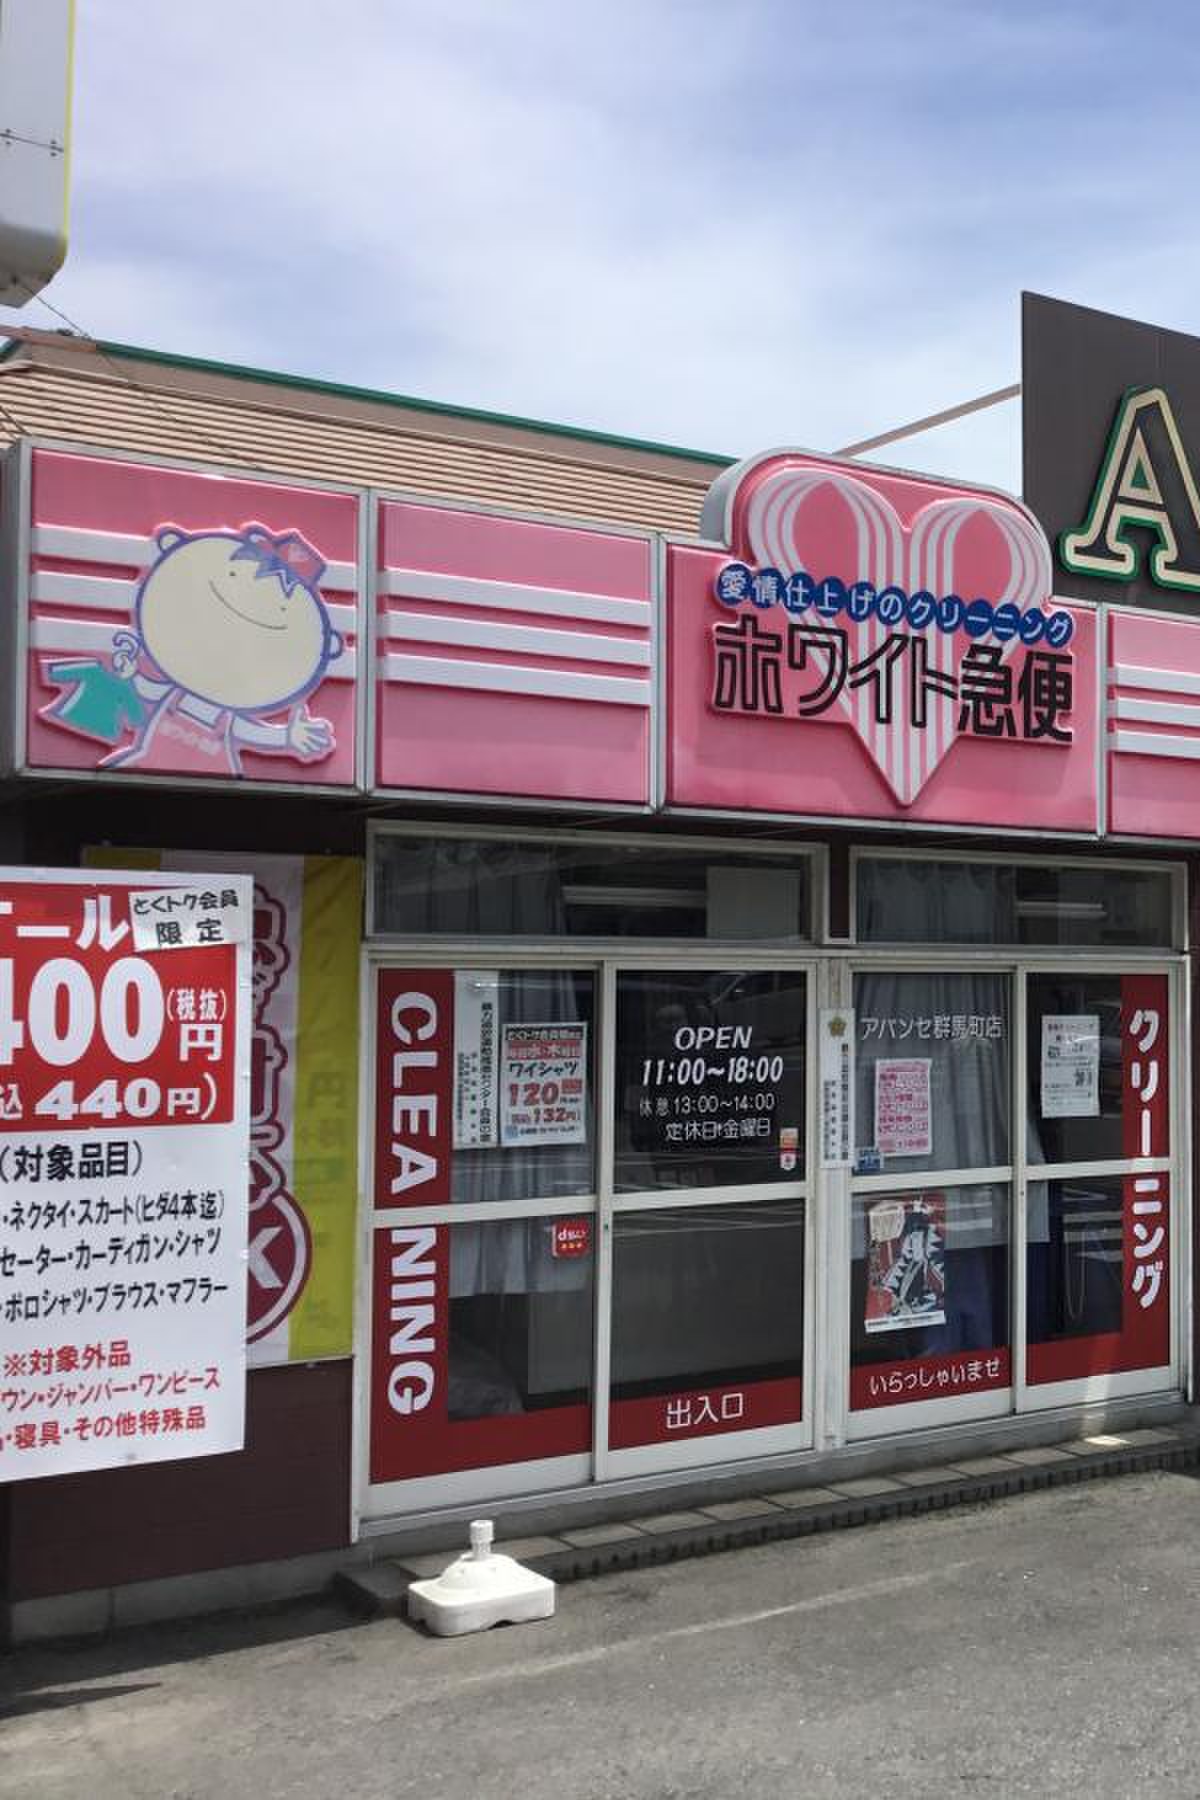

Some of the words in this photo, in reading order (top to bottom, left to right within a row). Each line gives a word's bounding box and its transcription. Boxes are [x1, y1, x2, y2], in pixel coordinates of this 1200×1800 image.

[718, 566, 1072, 646] 愛情仕上げのクリーニング
[713, 614, 1073, 742] ホワイト急便
[133, 889, 239, 915] とくトク会員
[0, 894, 131, 951] ール
[180, 1023, 223, 1062] 円
[675, 1026, 753, 1050] OPEN
[509, 1082, 559, 1106] 120
[0, 1141, 143, 1183] (対象品目)
[1128, 1009, 1165, 1308] クリーニング
[388, 991, 438, 1415] CLEANING
[869, 1357, 1001, 1395] いらっしゃいませ
[666, 1393, 744, 1430] 出入口
